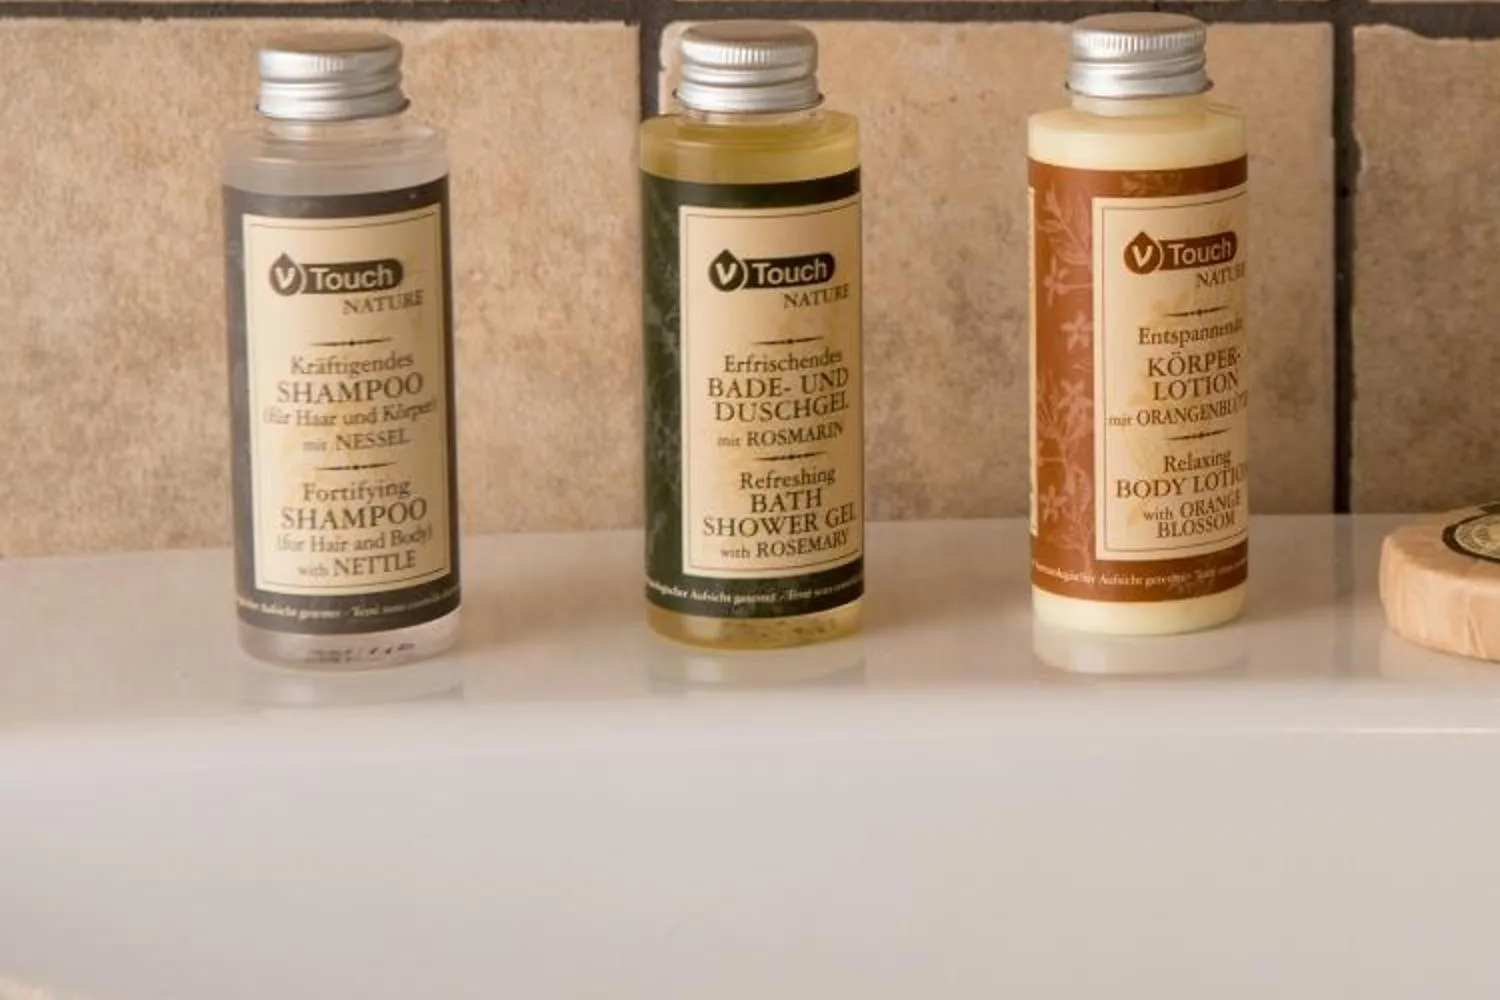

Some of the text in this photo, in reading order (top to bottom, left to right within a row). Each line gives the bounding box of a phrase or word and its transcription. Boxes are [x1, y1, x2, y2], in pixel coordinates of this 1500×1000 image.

[1167, 237, 1232, 266] Touch
[309, 262, 393, 290] Touch
[752, 258, 827, 285] Touch
[343, 289, 424, 315] NATURE
[291, 351, 414, 376] Kräftigendes
[277, 372, 424, 404] SHAMPOO
[708, 367, 849, 399] BADE- UND
[1152, 370, 1239, 401] LOTION
[296, 410, 337, 426] Haar
[343, 409, 378, 425] und
[714, 390, 849, 422] DUSCHGEL
[335, 429, 411, 451] NESSEL
[747, 421, 844, 447] ROSMARIN
[1163, 449, 1231, 473] Relaxing
[302, 479, 411, 503] Fortifying
[738, 467, 837, 491] Refreshing
[1116, 477, 1186, 499] BODY
[281, 498, 427, 530] SHAMPOO
[750, 487, 822, 514] BATH
[703, 502, 857, 538] SHOWER GEL
[1144, 508, 1173, 521] with
[1157, 511, 1236, 539] BLOSSOM
[311, 535, 348, 553] Hair
[354, 532, 385, 550] and
[720, 528, 849, 559] with ROSEMARY
[297, 550, 416, 577] with NETTLE
